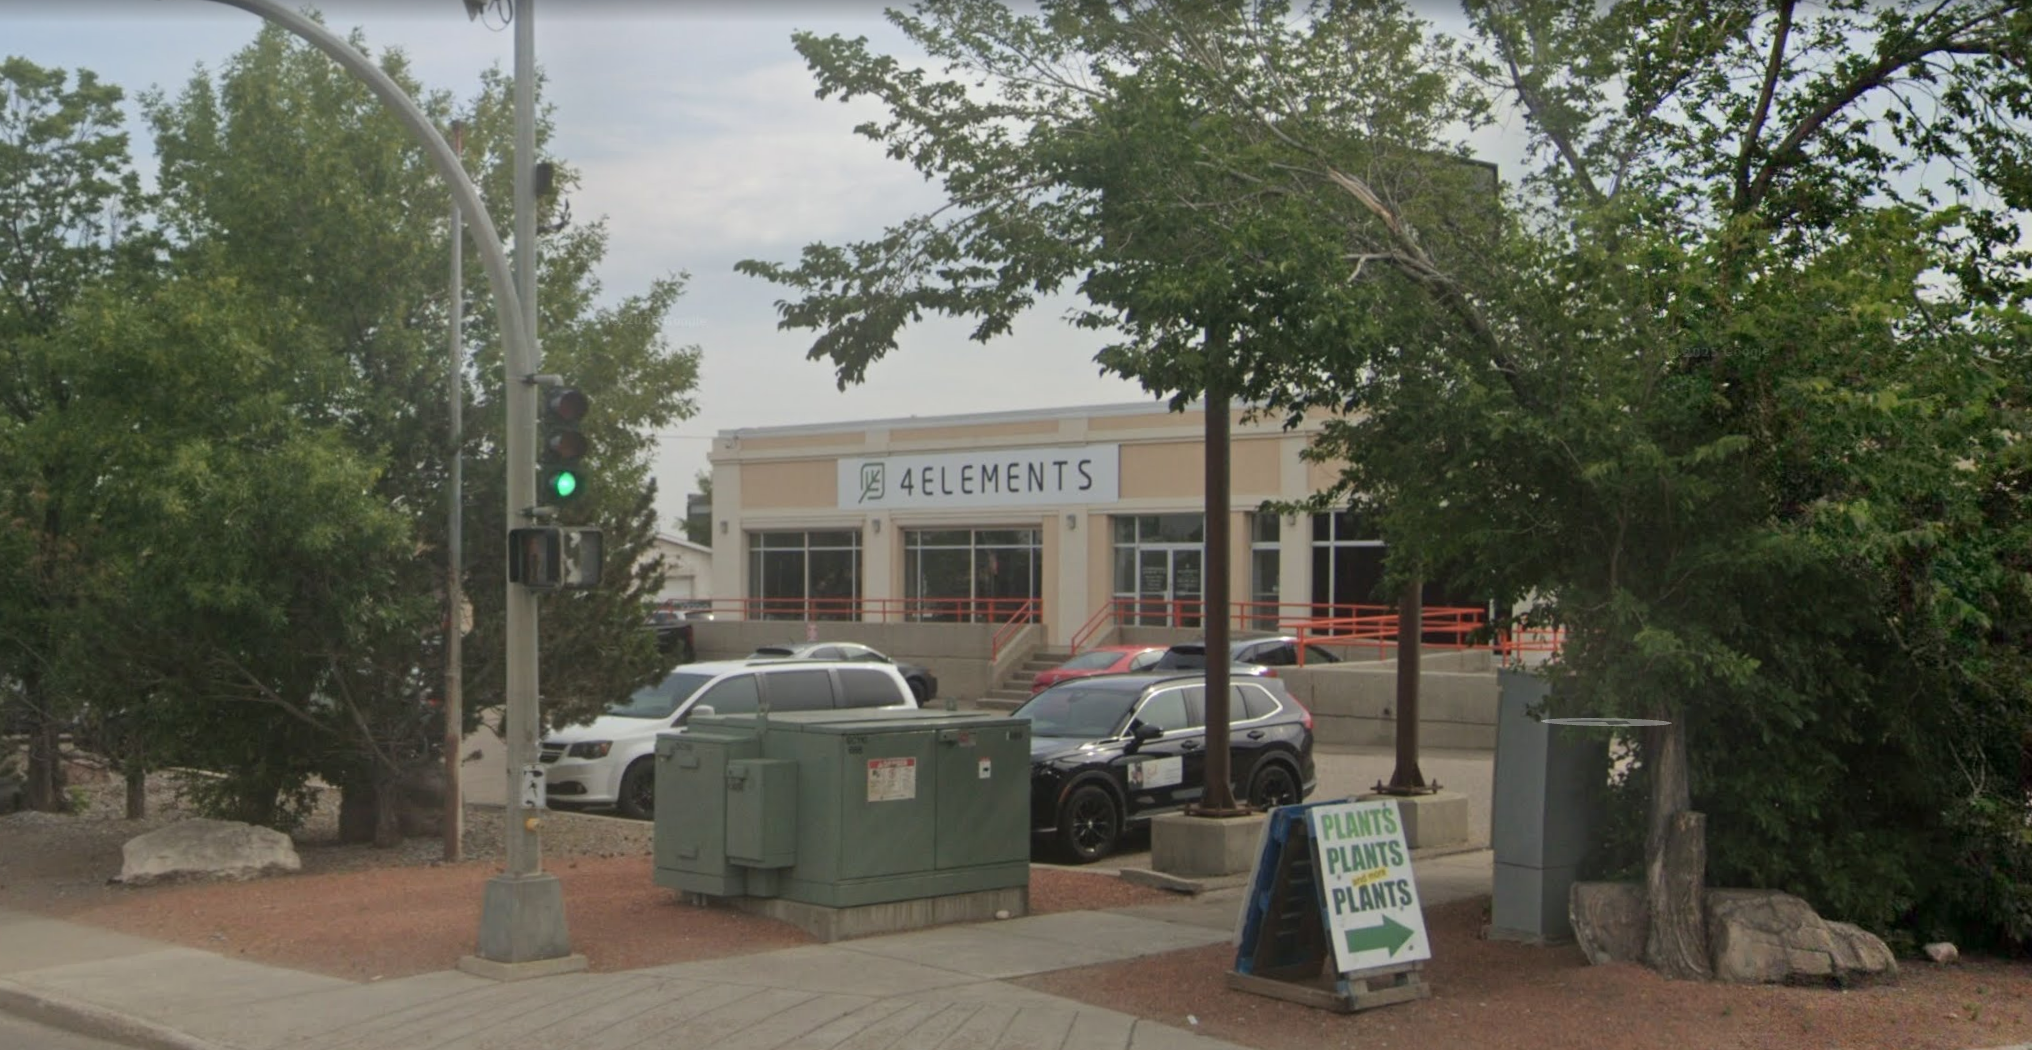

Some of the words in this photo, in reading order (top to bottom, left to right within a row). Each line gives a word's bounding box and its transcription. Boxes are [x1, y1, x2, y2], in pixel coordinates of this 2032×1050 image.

[900, 459, 1092, 496] 4ELEMENTS
[1321, 808, 1397, 841] PLANTS
[1327, 840, 1404, 874] PLANTS
[1368, 869, 1387, 880] more
[1332, 879, 1412, 915] PLANTS
